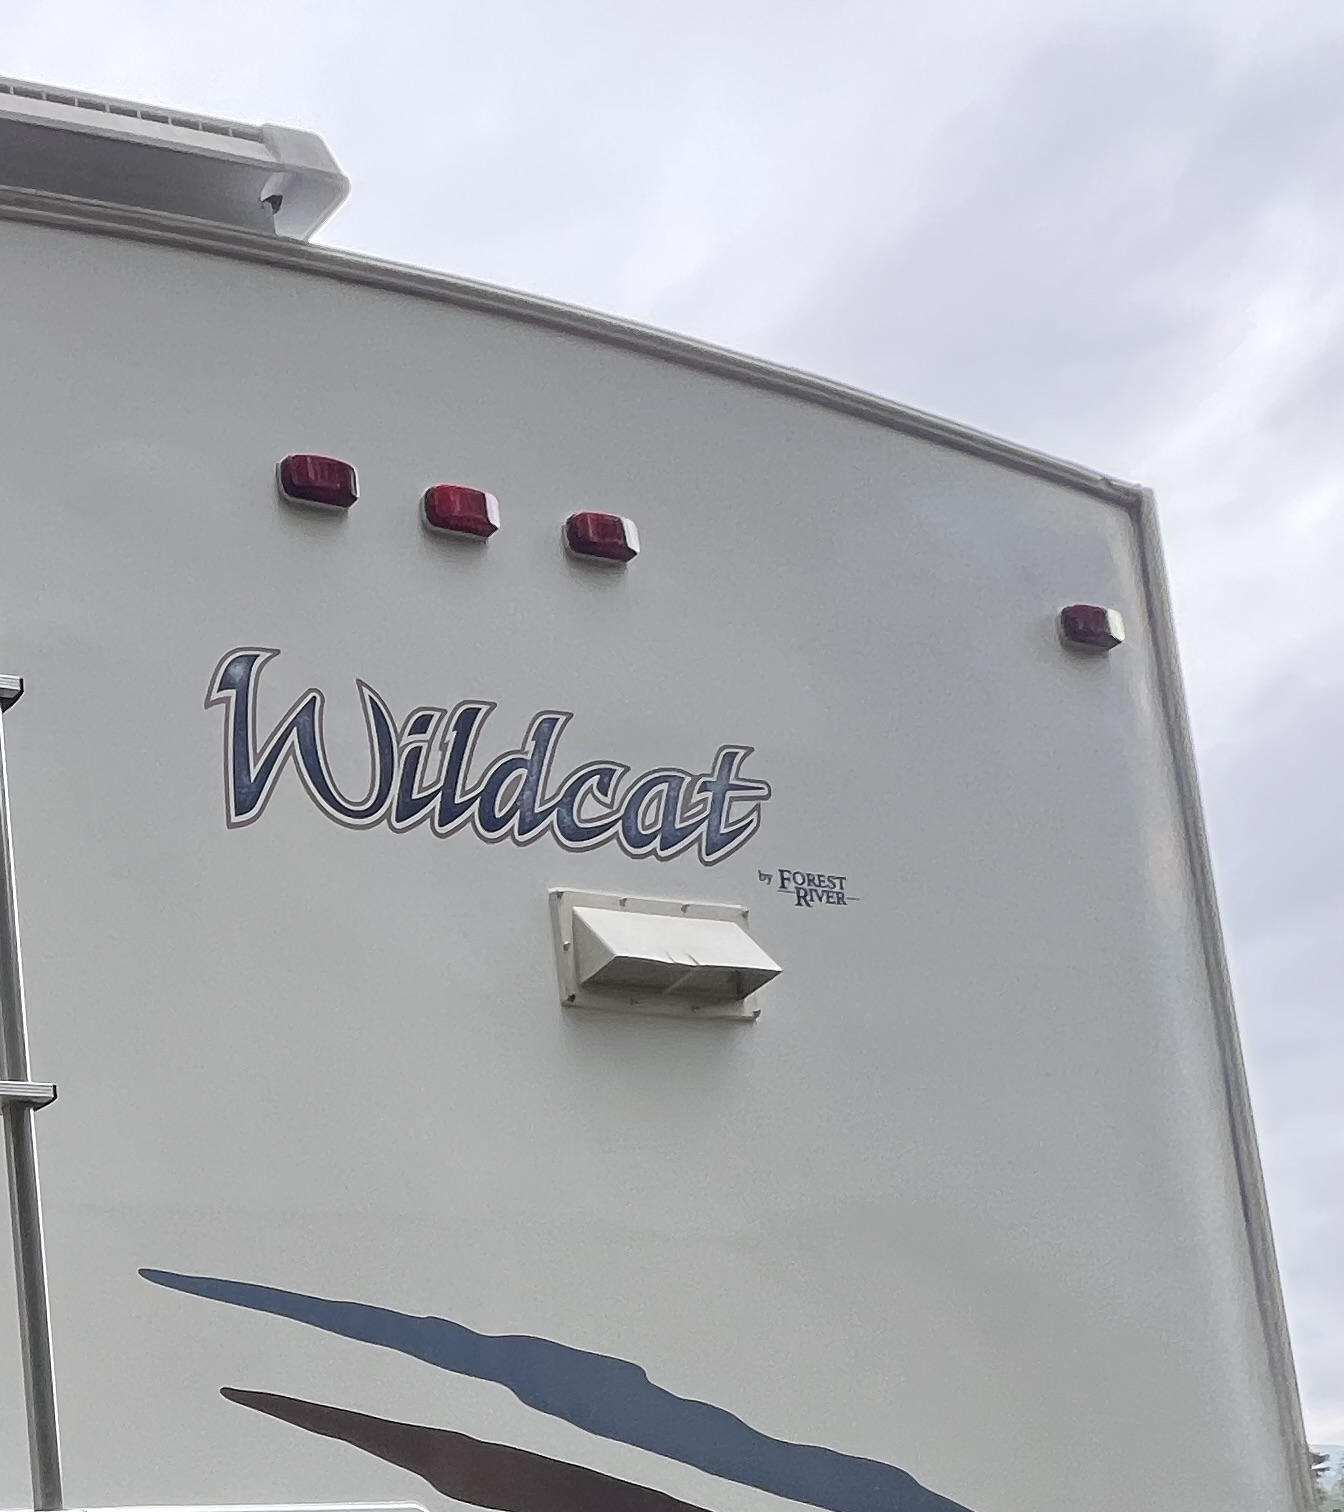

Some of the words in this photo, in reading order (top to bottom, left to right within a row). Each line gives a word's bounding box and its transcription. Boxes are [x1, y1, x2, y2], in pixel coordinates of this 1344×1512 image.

[204, 647, 772, 866] Wildcat
[757, 869, 774, 885] by
[778, 868, 847, 891] FOREST
[794, 886, 848, 908] RIVER
